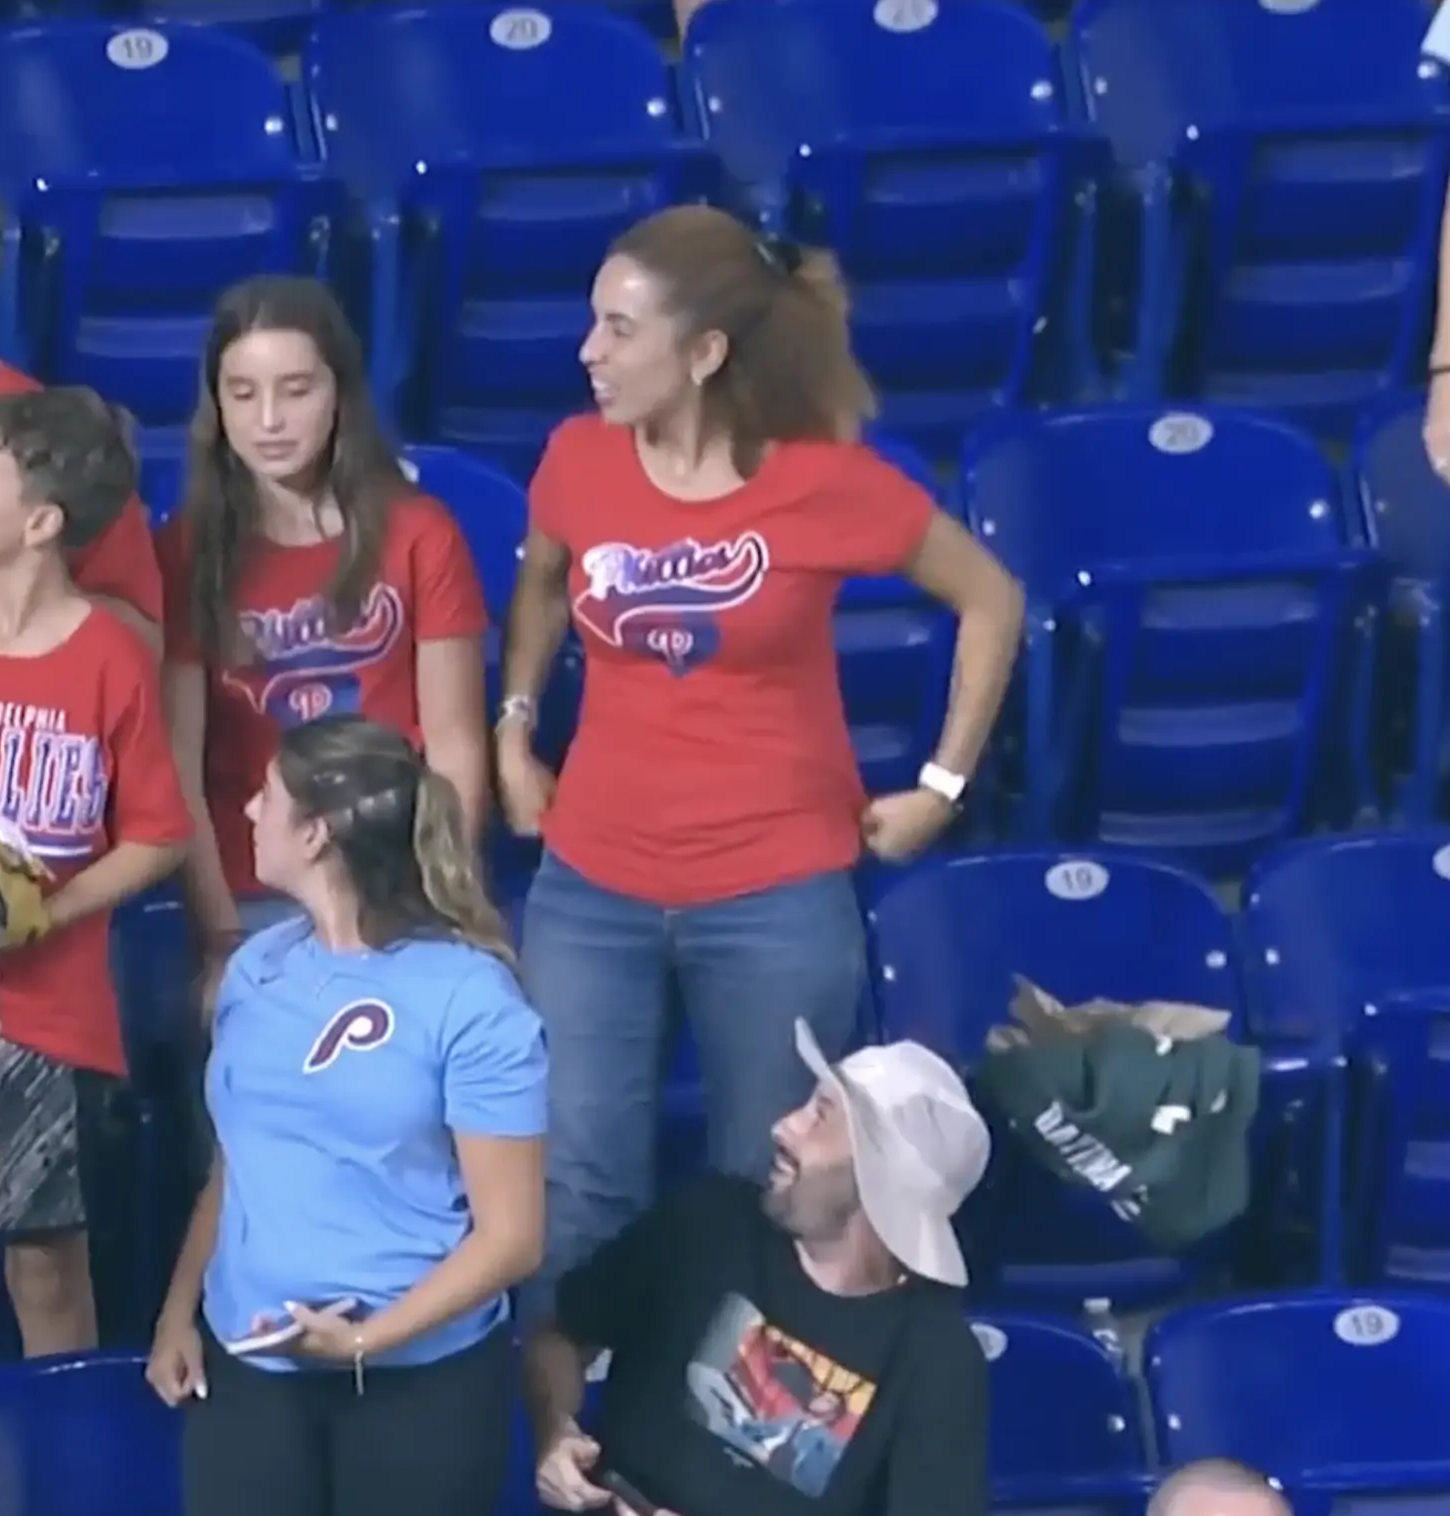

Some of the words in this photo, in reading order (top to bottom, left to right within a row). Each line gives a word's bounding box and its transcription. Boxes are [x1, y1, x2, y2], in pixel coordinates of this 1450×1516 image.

[505, 17, 537, 41] 20
[122, 36, 152, 60] 19
[1062, 868, 1092, 892] 19
[1350, 1311, 1382, 1337] 19
